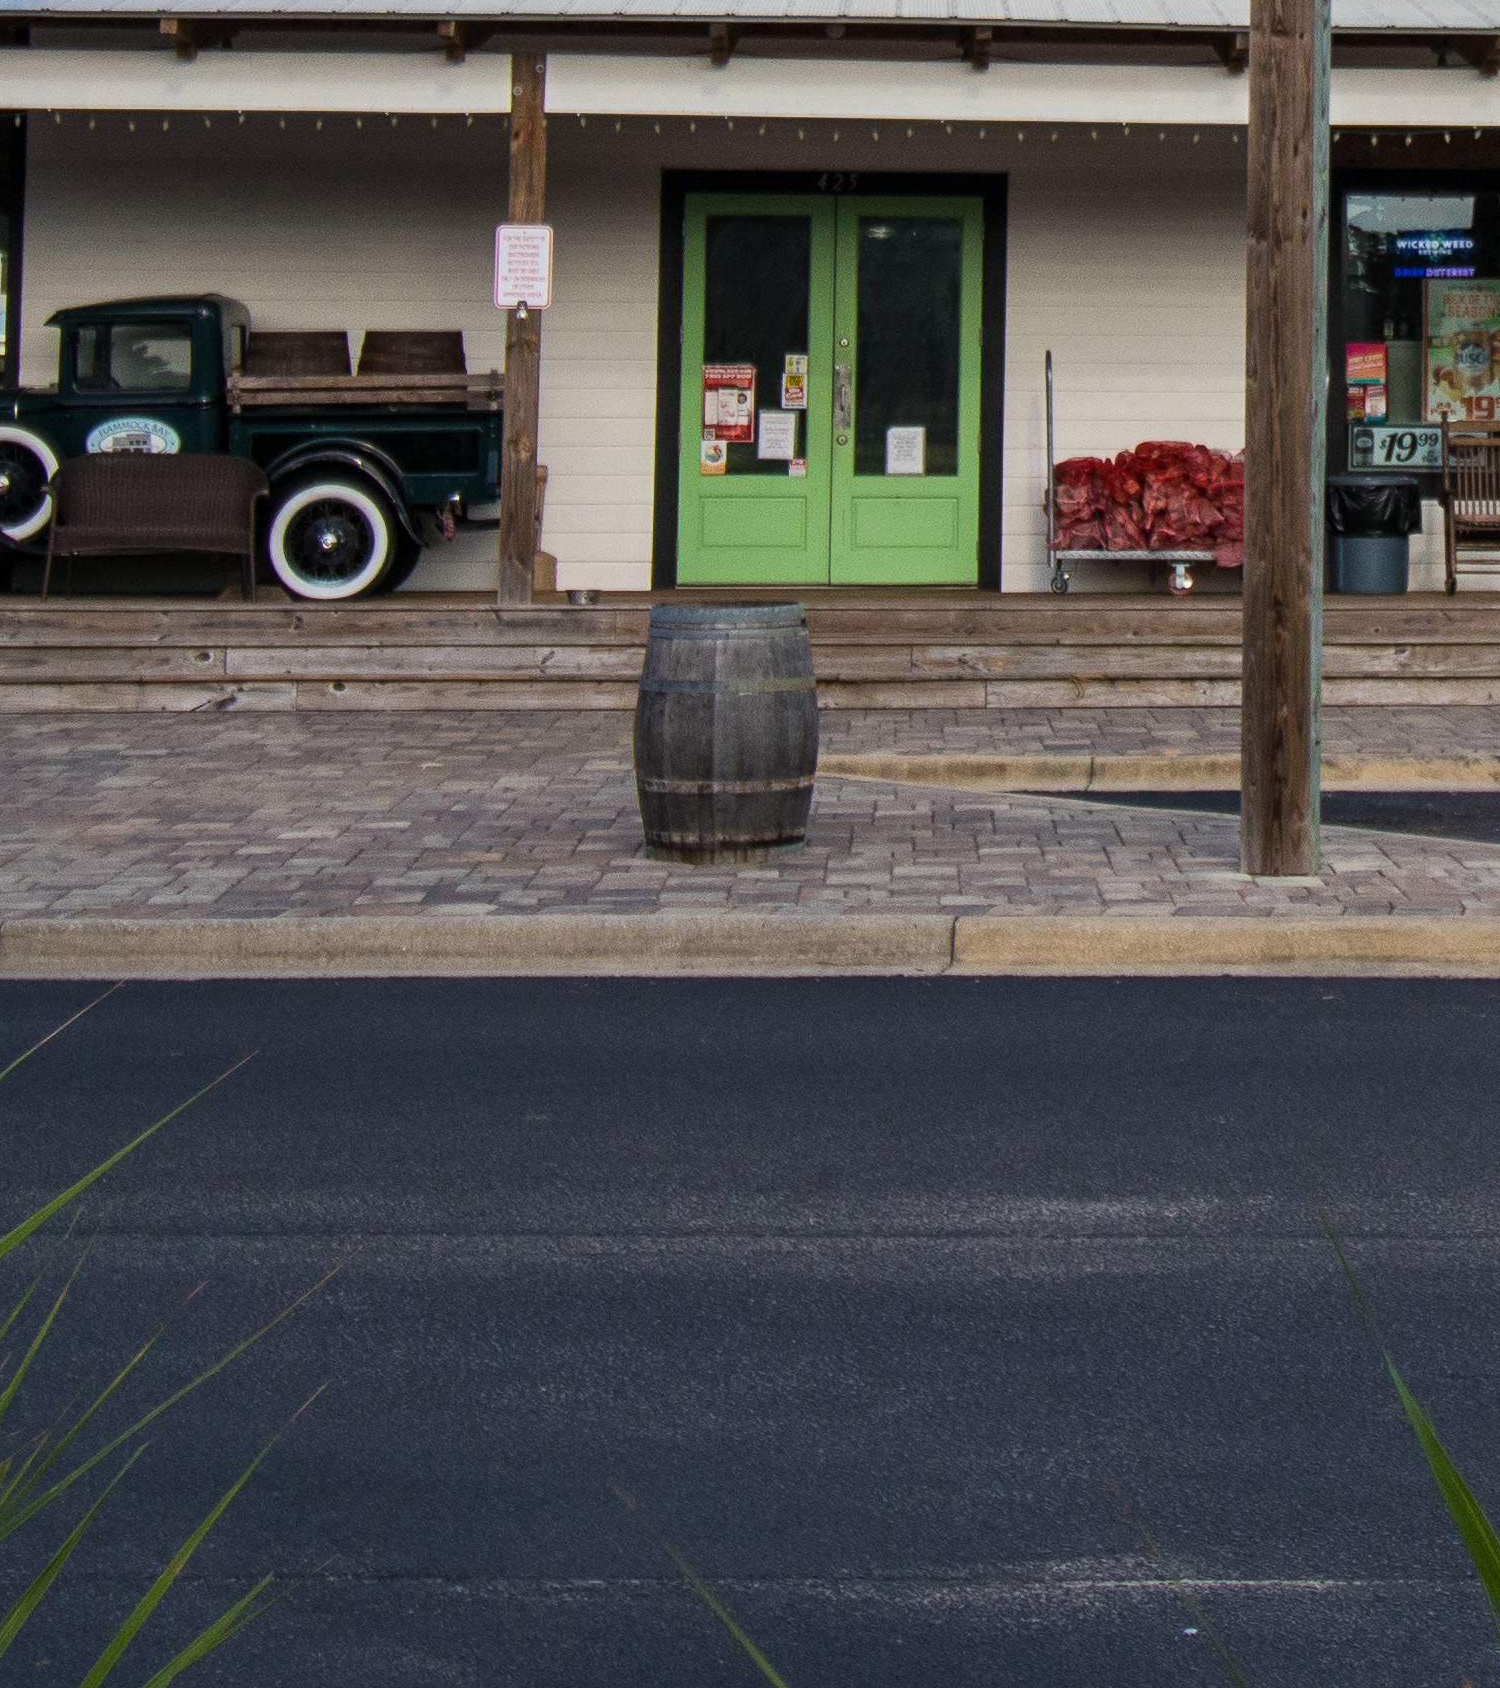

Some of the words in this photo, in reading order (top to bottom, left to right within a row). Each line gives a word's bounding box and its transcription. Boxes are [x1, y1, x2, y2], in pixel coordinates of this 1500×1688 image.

[817, 173, 859, 192] 425
[1396, 240, 1440, 249] WICKED
[1442, 240, 1473, 249] WEED
[99, 421, 150, 437] HAMMOCK
[153, 424, 171, 436] BAY
